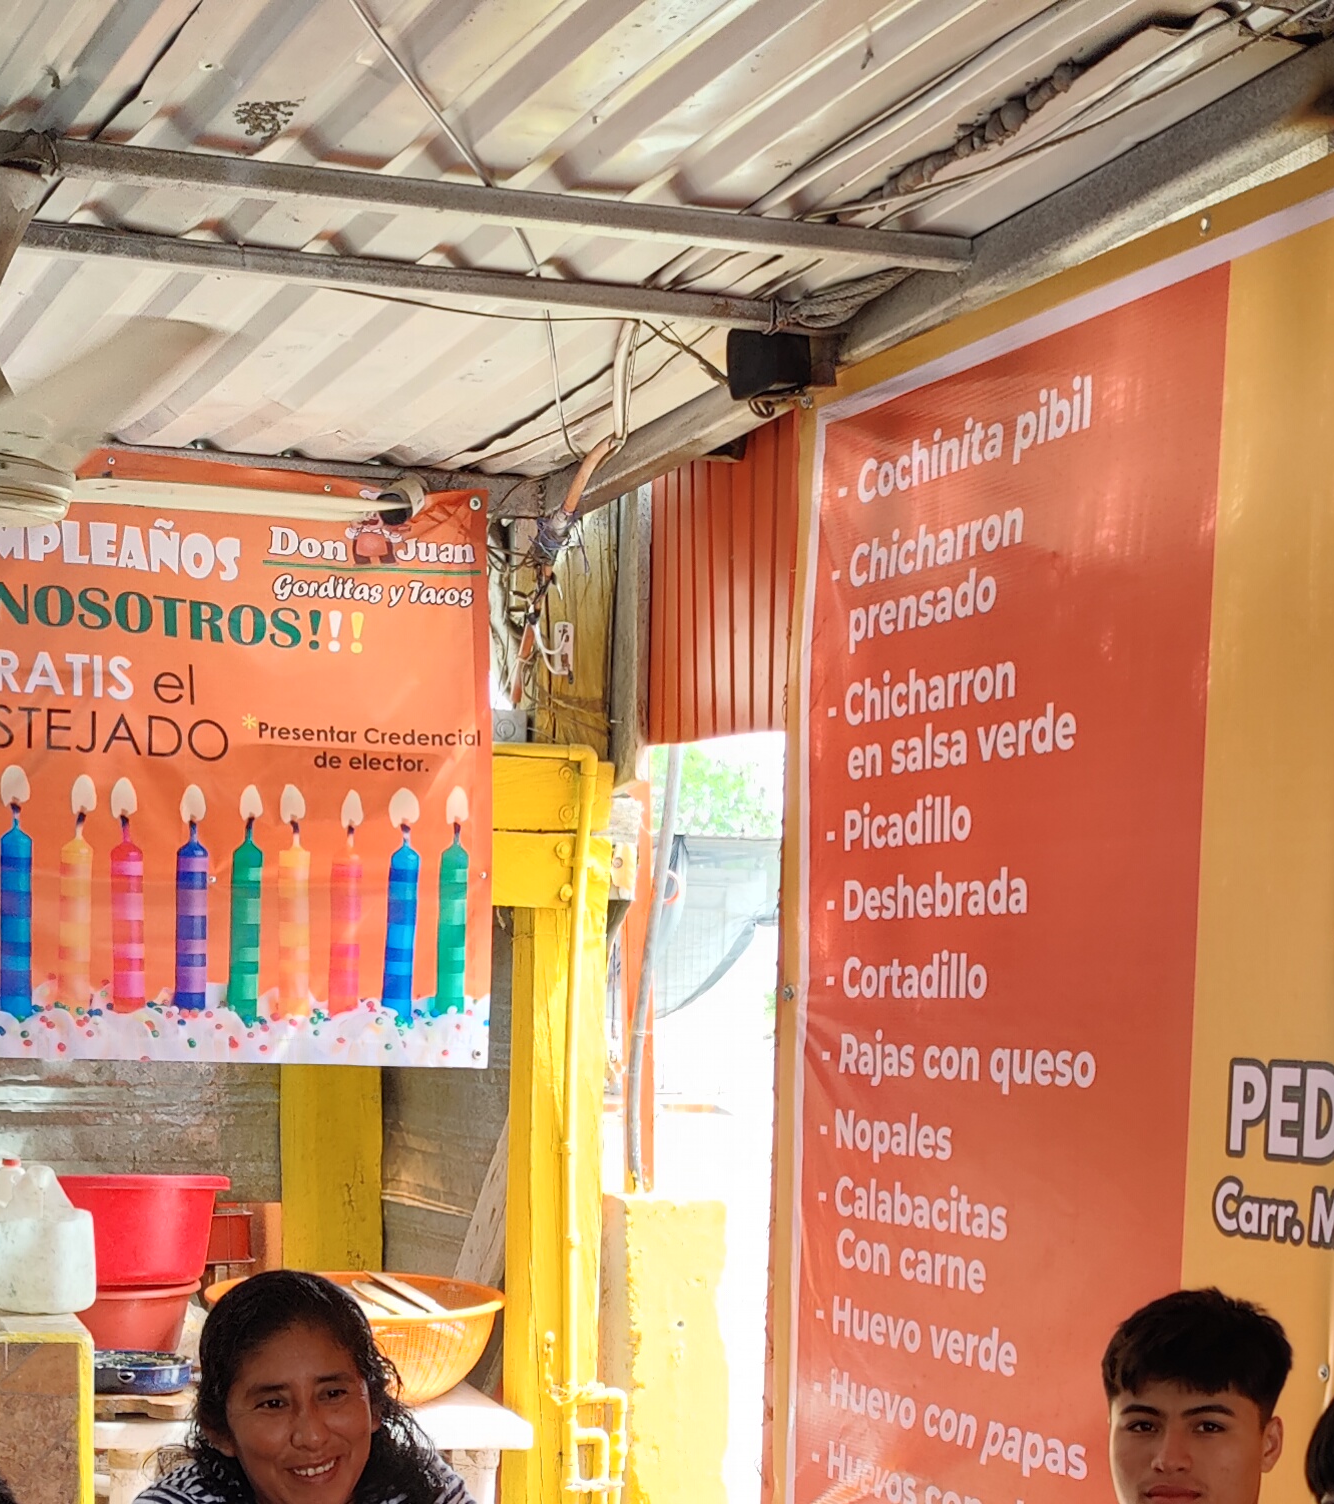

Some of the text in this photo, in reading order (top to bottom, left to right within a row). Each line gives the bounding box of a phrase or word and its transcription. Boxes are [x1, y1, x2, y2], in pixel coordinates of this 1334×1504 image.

[857, 375, 1094, 505] Cochinita pibil
[268, 524, 476, 565] Don Juan
[849, 506, 1025, 588] Chicharron
[272, 573, 474, 608] Gorditas y Tacos
[849, 568, 998, 654] prensado
[153, 663, 195, 706] el
[844, 660, 1017, 728] Chicharron
[313, 751, 430, 774] de elector.
[363, 726, 482, 748] Credencial
[847, 702, 1077, 781] en salsa verde
[843, 795, 973, 852] Picadillo
[843, 866, 1029, 922] Deshebrada
[842, 952, 989, 1001] Cortadillo
[838, 1030, 1097, 1096] Rajas con queso
[835, 1109, 954, 1163] Nopales
[835, 1176, 1009, 1242] Calabacitas
[1212, 1178, 1307, 1248] Carr.
[836, 1229, 987, 1295] Con carne
[831, 1295, 1019, 1378] Huevo verde
[828, 1368, 1089, 1482] Huevo con papas
